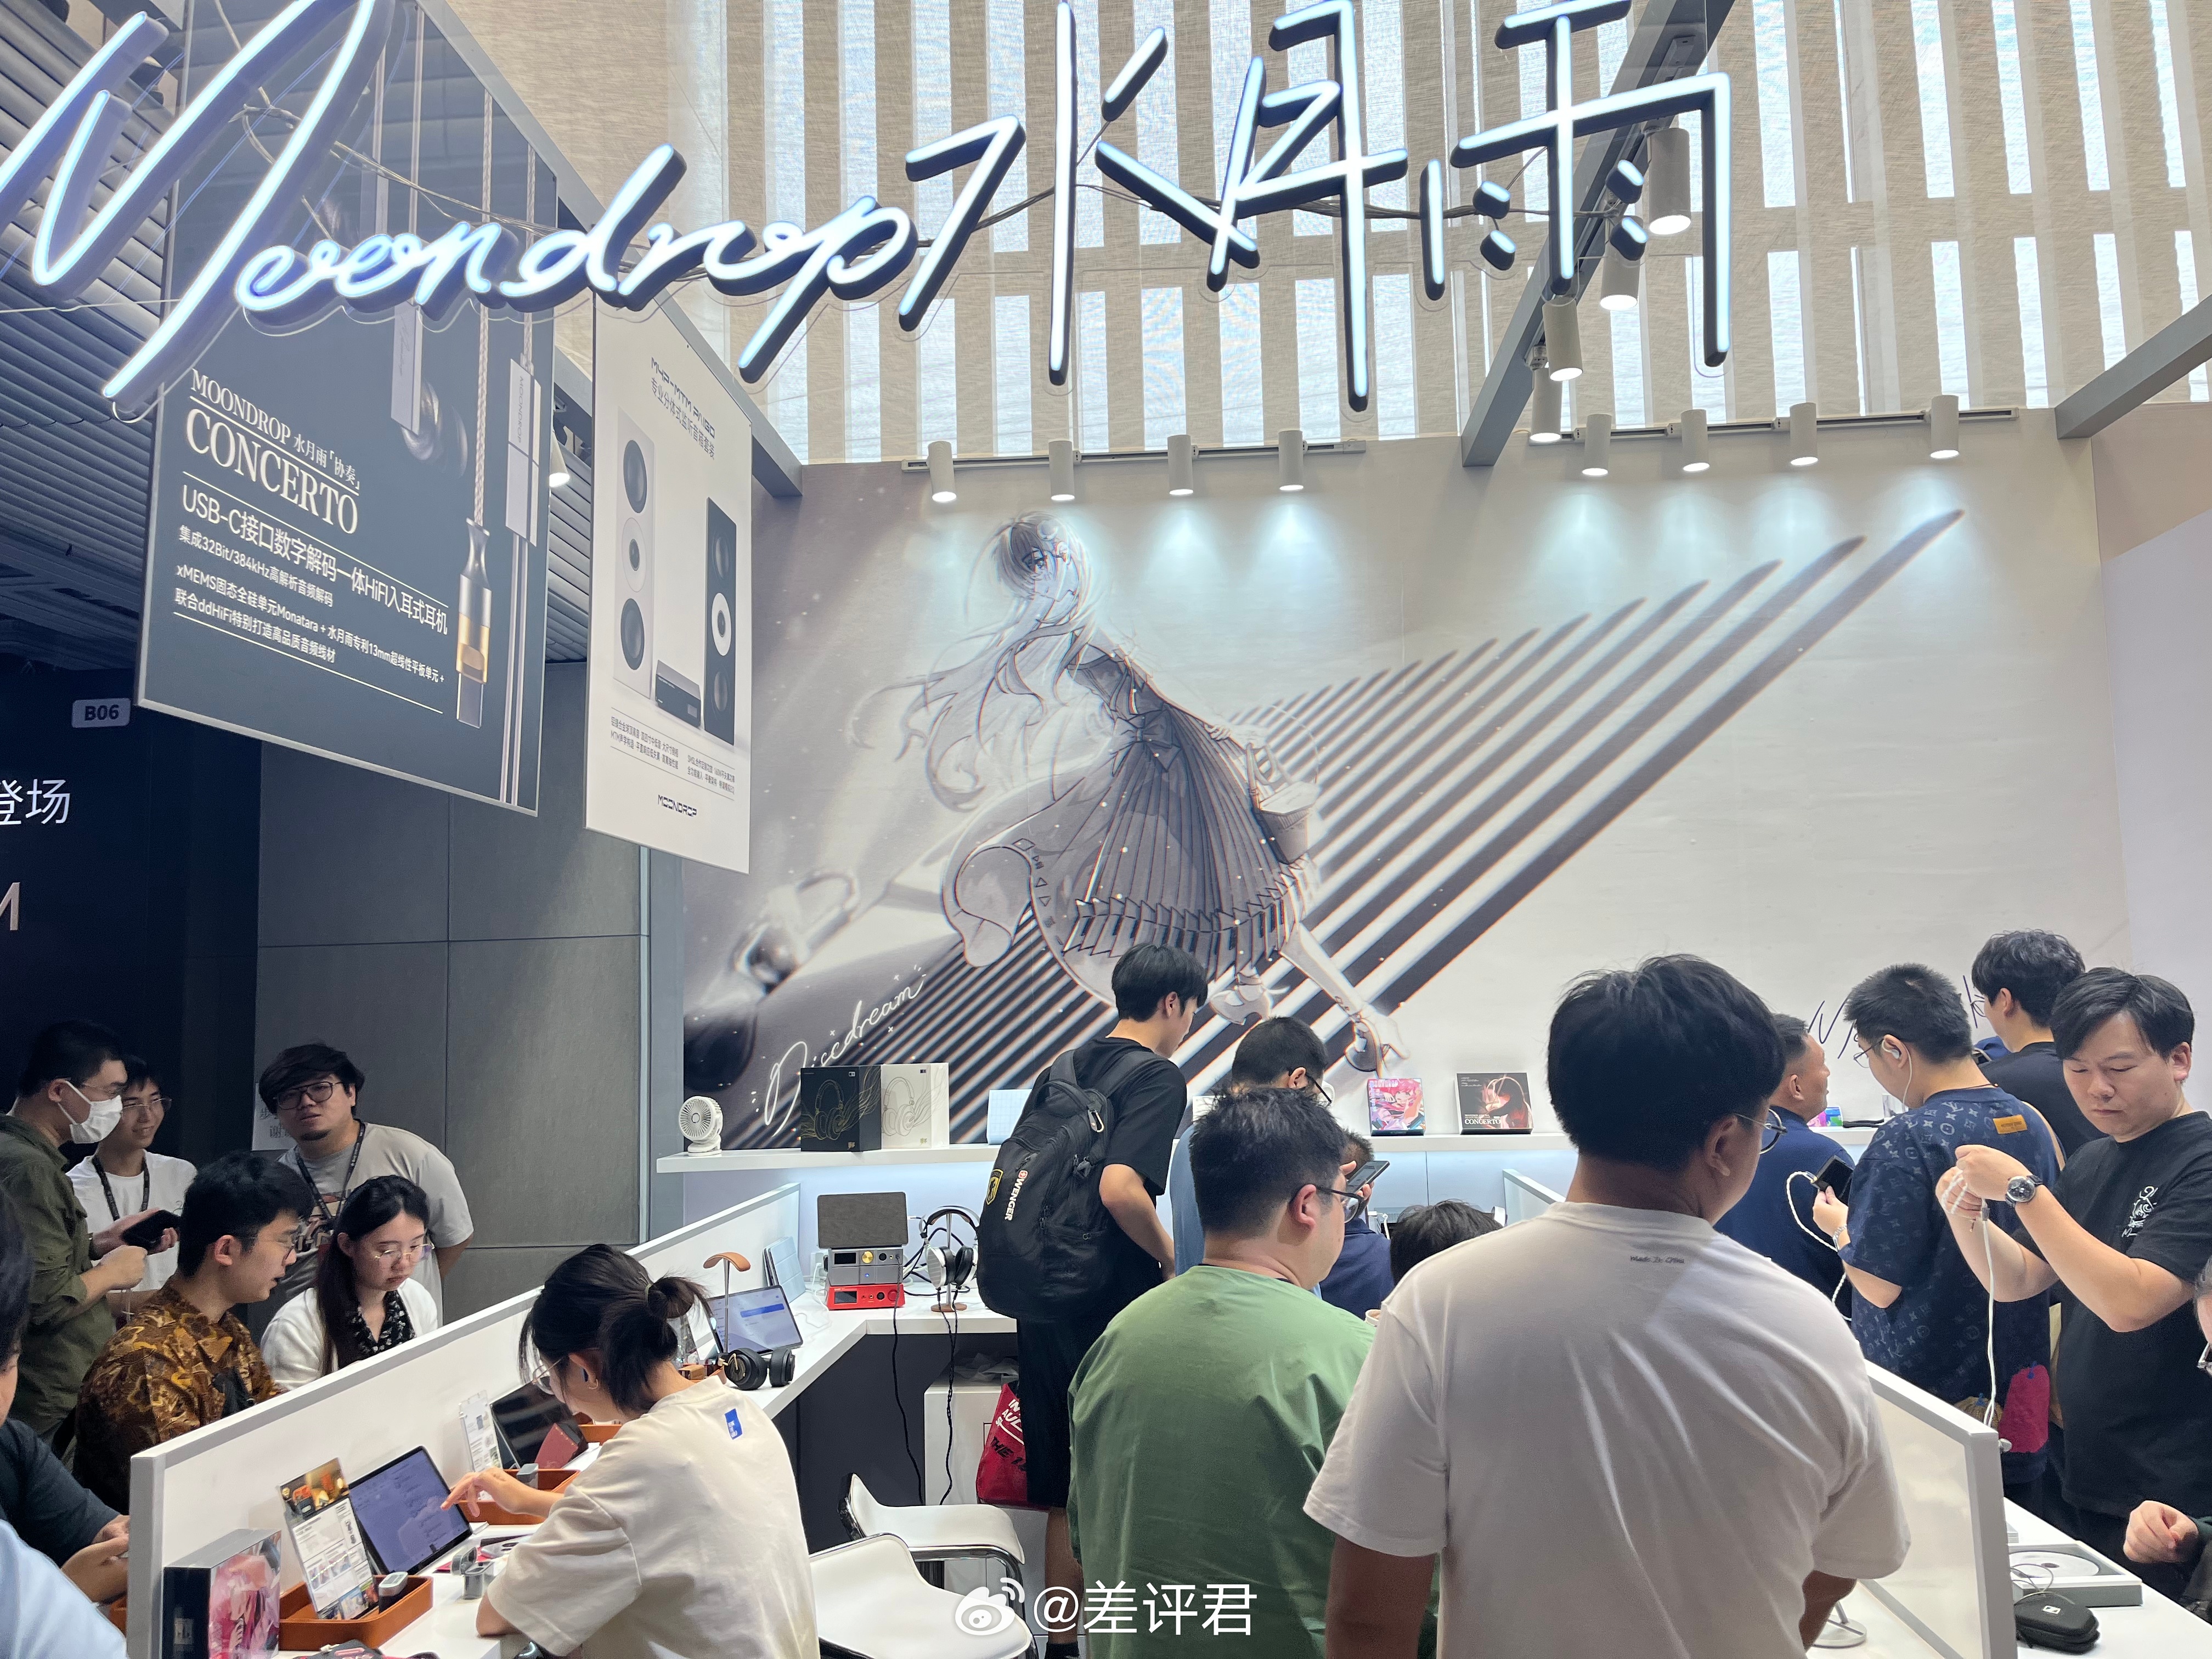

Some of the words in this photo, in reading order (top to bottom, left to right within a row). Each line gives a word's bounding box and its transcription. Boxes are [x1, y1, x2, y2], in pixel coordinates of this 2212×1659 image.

[190, 368, 291, 445] MOONDROP
[651, 377, 715, 460] 专业分体式监听音箱套装
[186, 408, 358, 534] CONCERTO
[178, 524, 334, 607] 集成32Bit/384kHz高解析音频解码
[84, 704, 120, 721] B06
[658, 794, 697, 817] MOONDROP
[1004, 1178, 1025, 1221] WENGER
